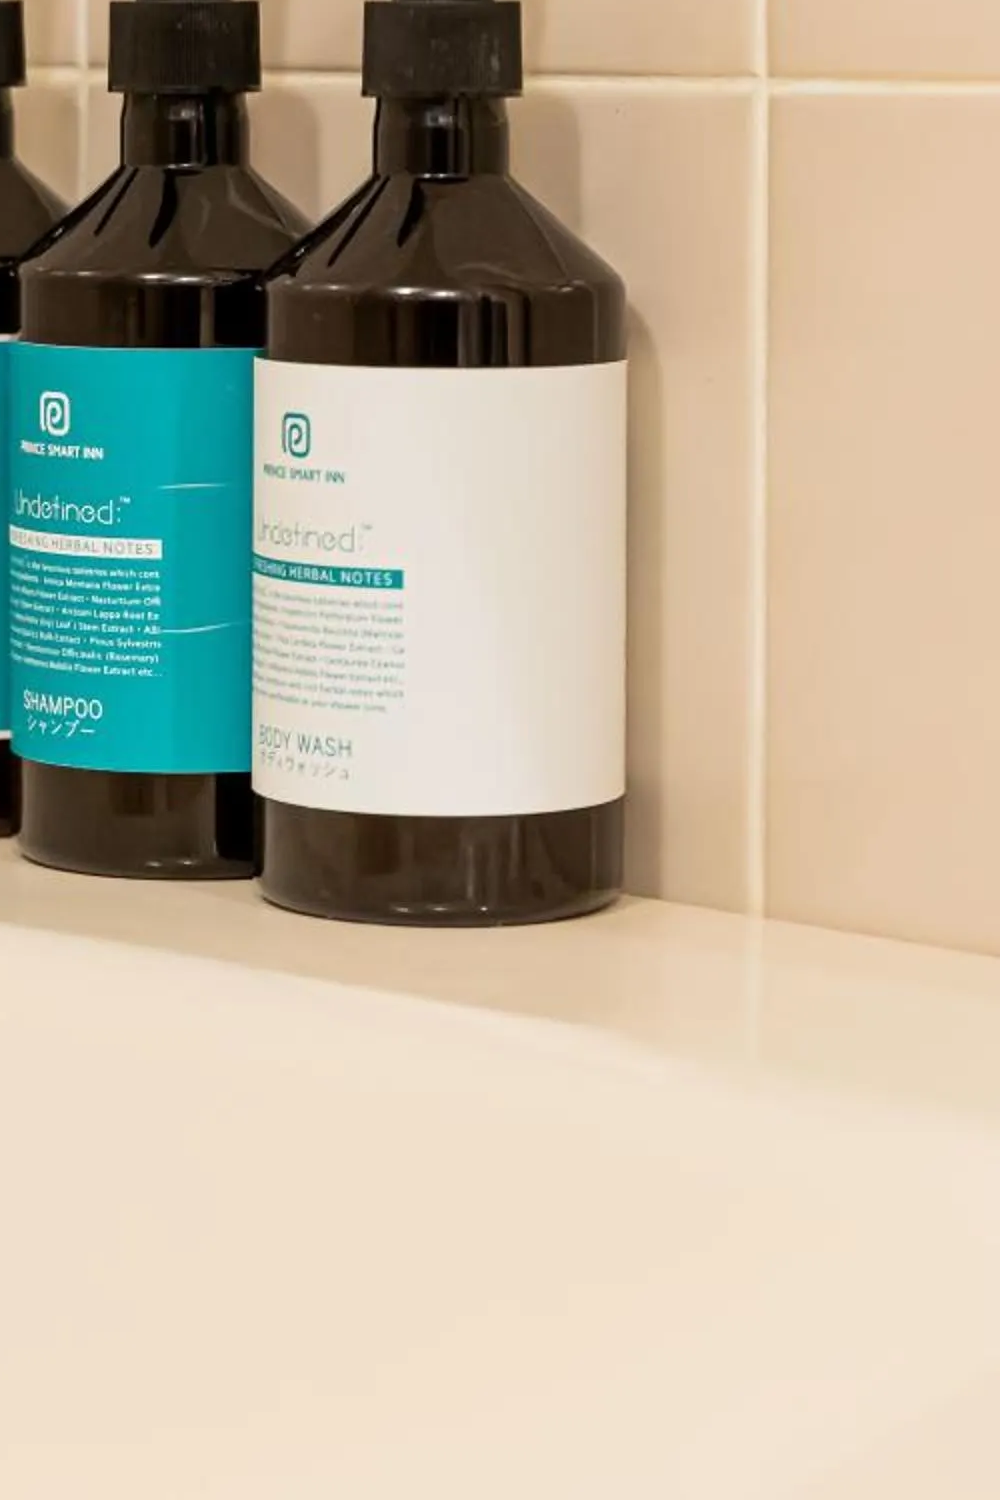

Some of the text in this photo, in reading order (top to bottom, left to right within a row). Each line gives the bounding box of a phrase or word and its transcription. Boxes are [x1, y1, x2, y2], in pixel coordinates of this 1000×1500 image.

[48, 443, 81, 459] SMART
[83, 447, 104, 461] INN
[290, 467, 321, 482] SMART
[325, 470, 346, 484] INN
[51, 536, 97, 551] HERBAL
[103, 540, 153, 555] NOTES
[289, 565, 338, 583] HERBAL
[340, 571, 394, 587] NOTES
[23, 689, 103, 720] SHAMPOO
[27, 715, 96, 738] シャンプー
[259, 724, 353, 758] BODY WASH
